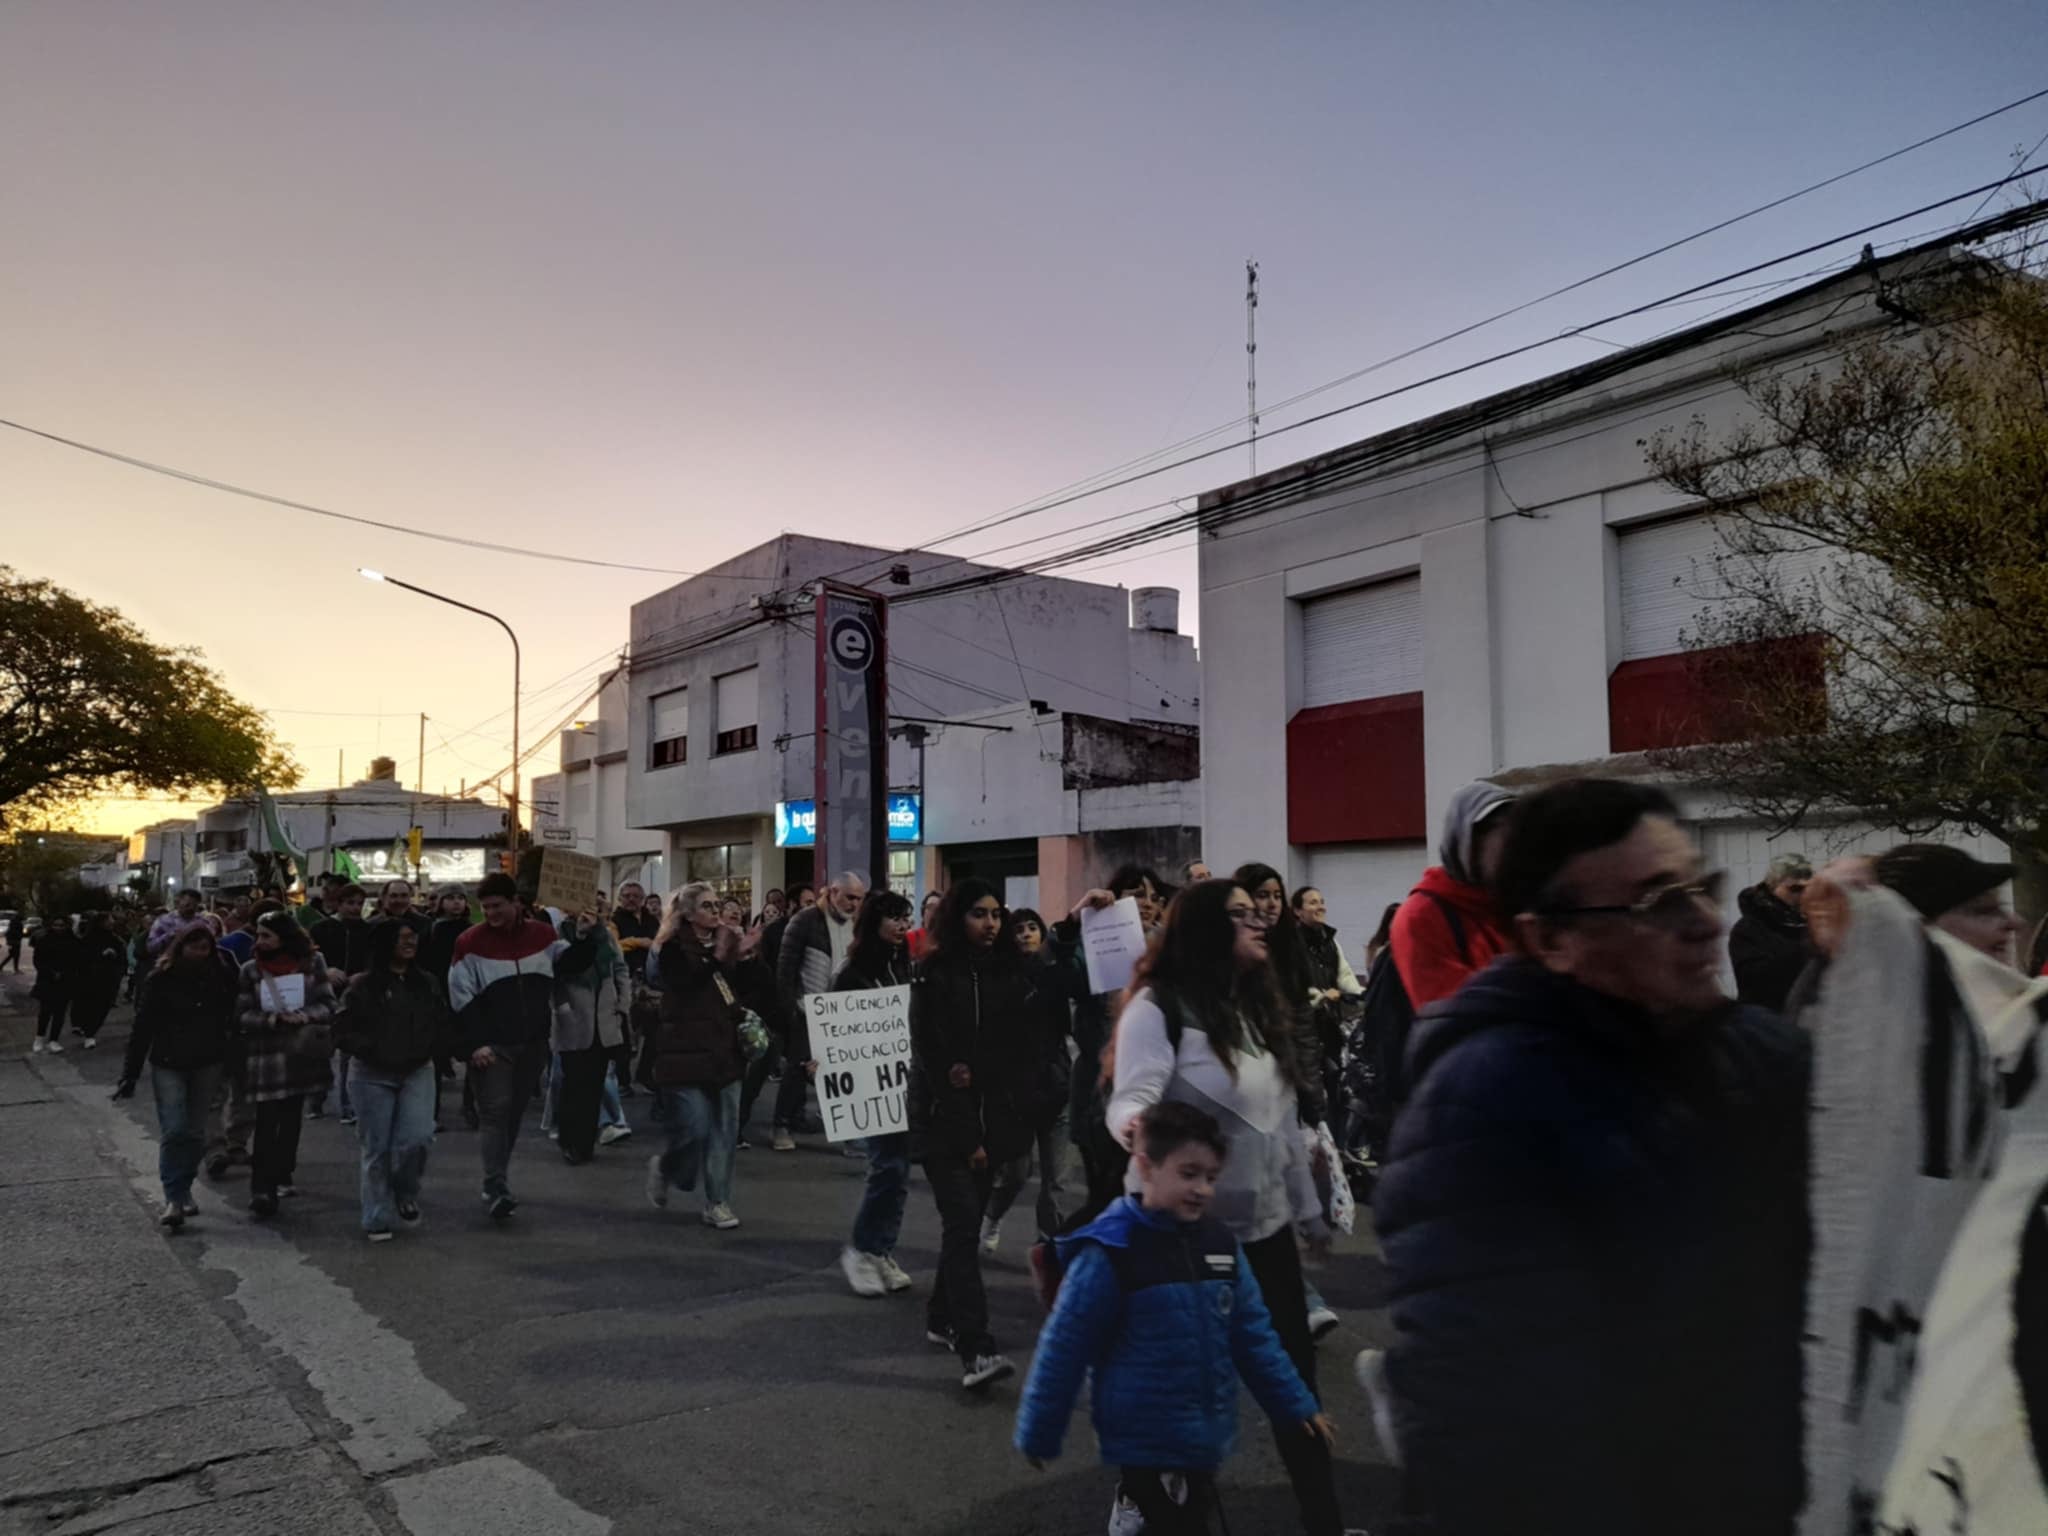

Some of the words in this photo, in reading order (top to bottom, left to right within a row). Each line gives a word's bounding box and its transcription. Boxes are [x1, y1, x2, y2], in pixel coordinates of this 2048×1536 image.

[814, 996, 838, 1016] SIN
[845, 994, 902, 1013] CIENCIA
[820, 1015, 907, 1038] TECNOLOGÍA
[826, 1032, 909, 1064] EDUCACIÓ
[823, 1072, 854, 1099] NO
[875, 1060, 911, 1091] HA
